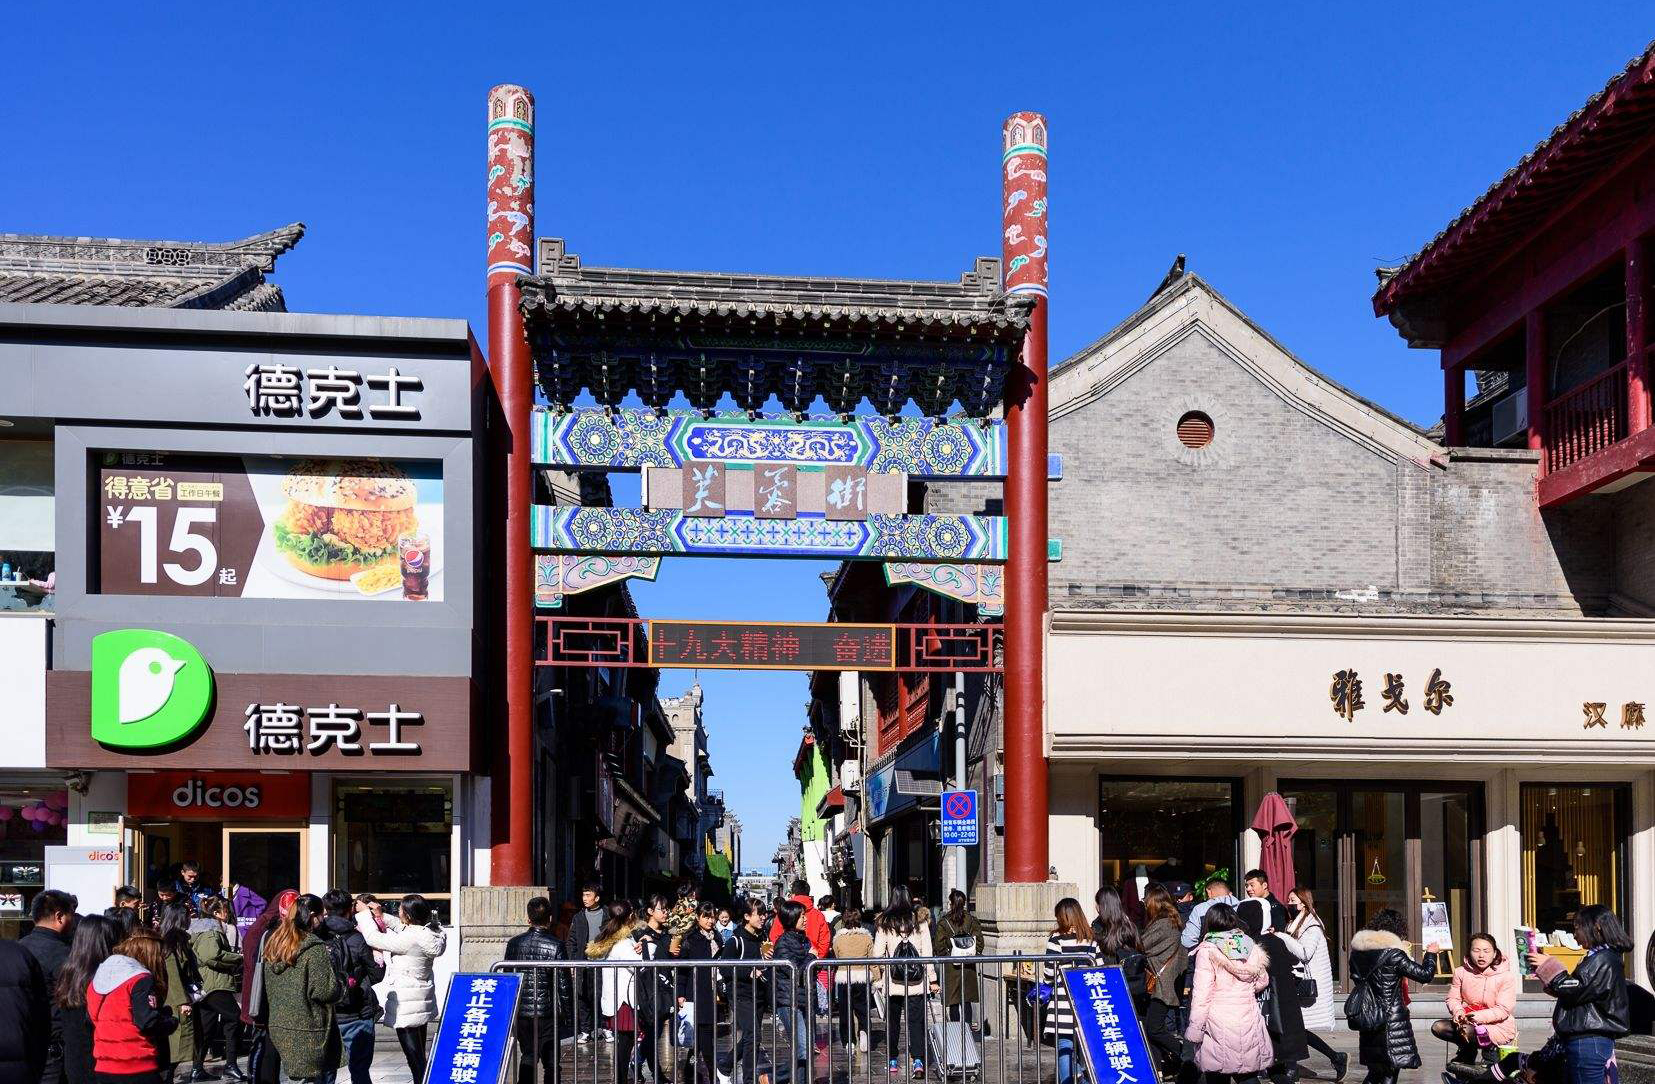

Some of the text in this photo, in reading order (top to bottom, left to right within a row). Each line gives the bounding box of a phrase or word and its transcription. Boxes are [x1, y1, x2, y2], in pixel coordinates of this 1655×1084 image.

[245, 364, 423, 418] 德克士
[105, 476, 174, 500] 得意省
[652, 629, 800, 661] 十九大精神
[1329, 668, 1455, 723] 雅戈尔
[1582, 700, 1647, 730] 汉麻
[245, 703, 423, 755] 德克士
[172, 779, 260, 808] dicos
[450, 978, 498, 1084] 禁止各种车辆驶
[1082, 971, 1139, 1084] 禁止各种车辆驶入
